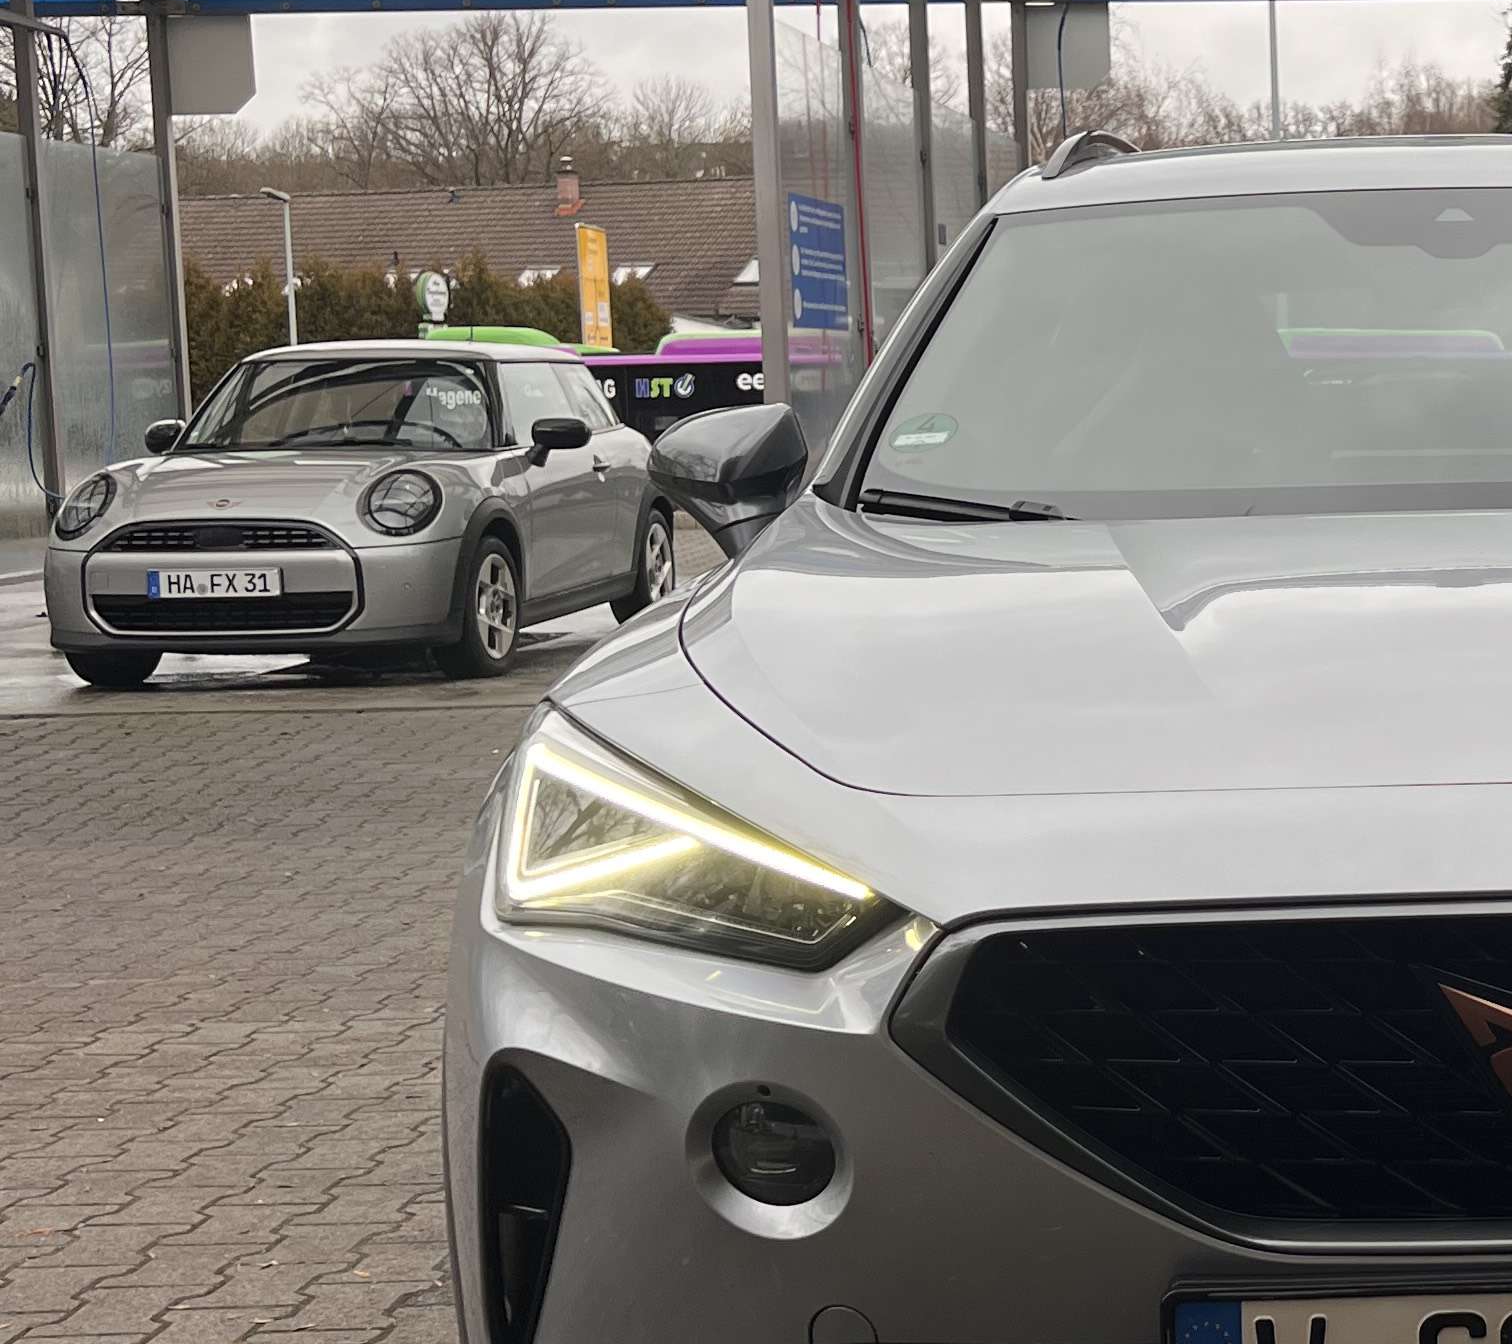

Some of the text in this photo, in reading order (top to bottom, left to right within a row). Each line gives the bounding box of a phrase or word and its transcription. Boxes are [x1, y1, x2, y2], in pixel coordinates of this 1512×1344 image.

[635, 377, 674, 398] HST
[167, 573, 271, 594] HA FX 31
